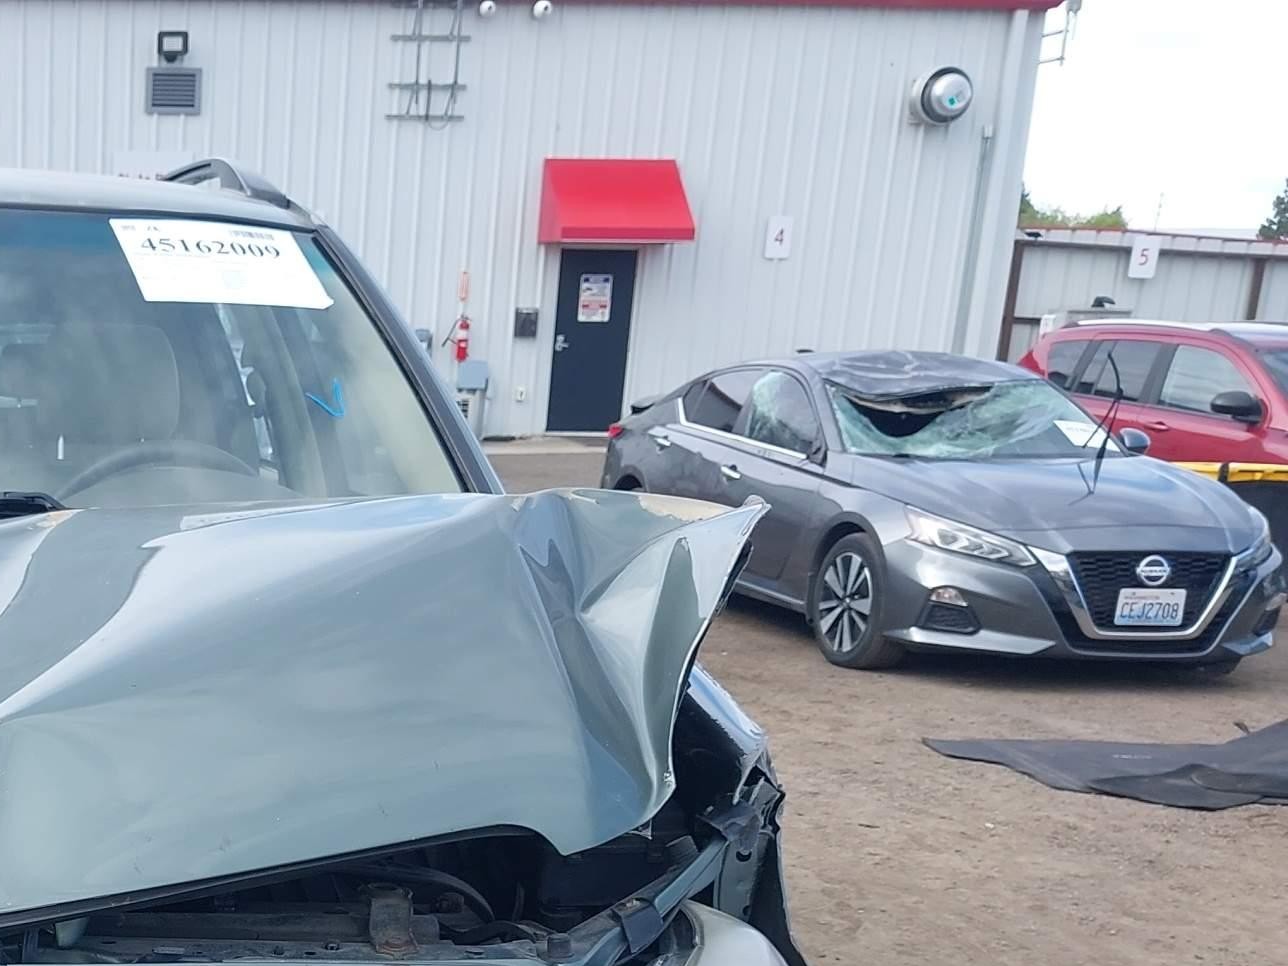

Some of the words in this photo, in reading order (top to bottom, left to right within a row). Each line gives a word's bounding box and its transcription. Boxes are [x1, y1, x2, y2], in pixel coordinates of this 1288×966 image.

[774, 228, 784, 246] 4
[141, 237, 280, 259] 45162009
[1138, 248, 1150, 266] 5
[1120, 602, 1179, 620] CEJ2708
